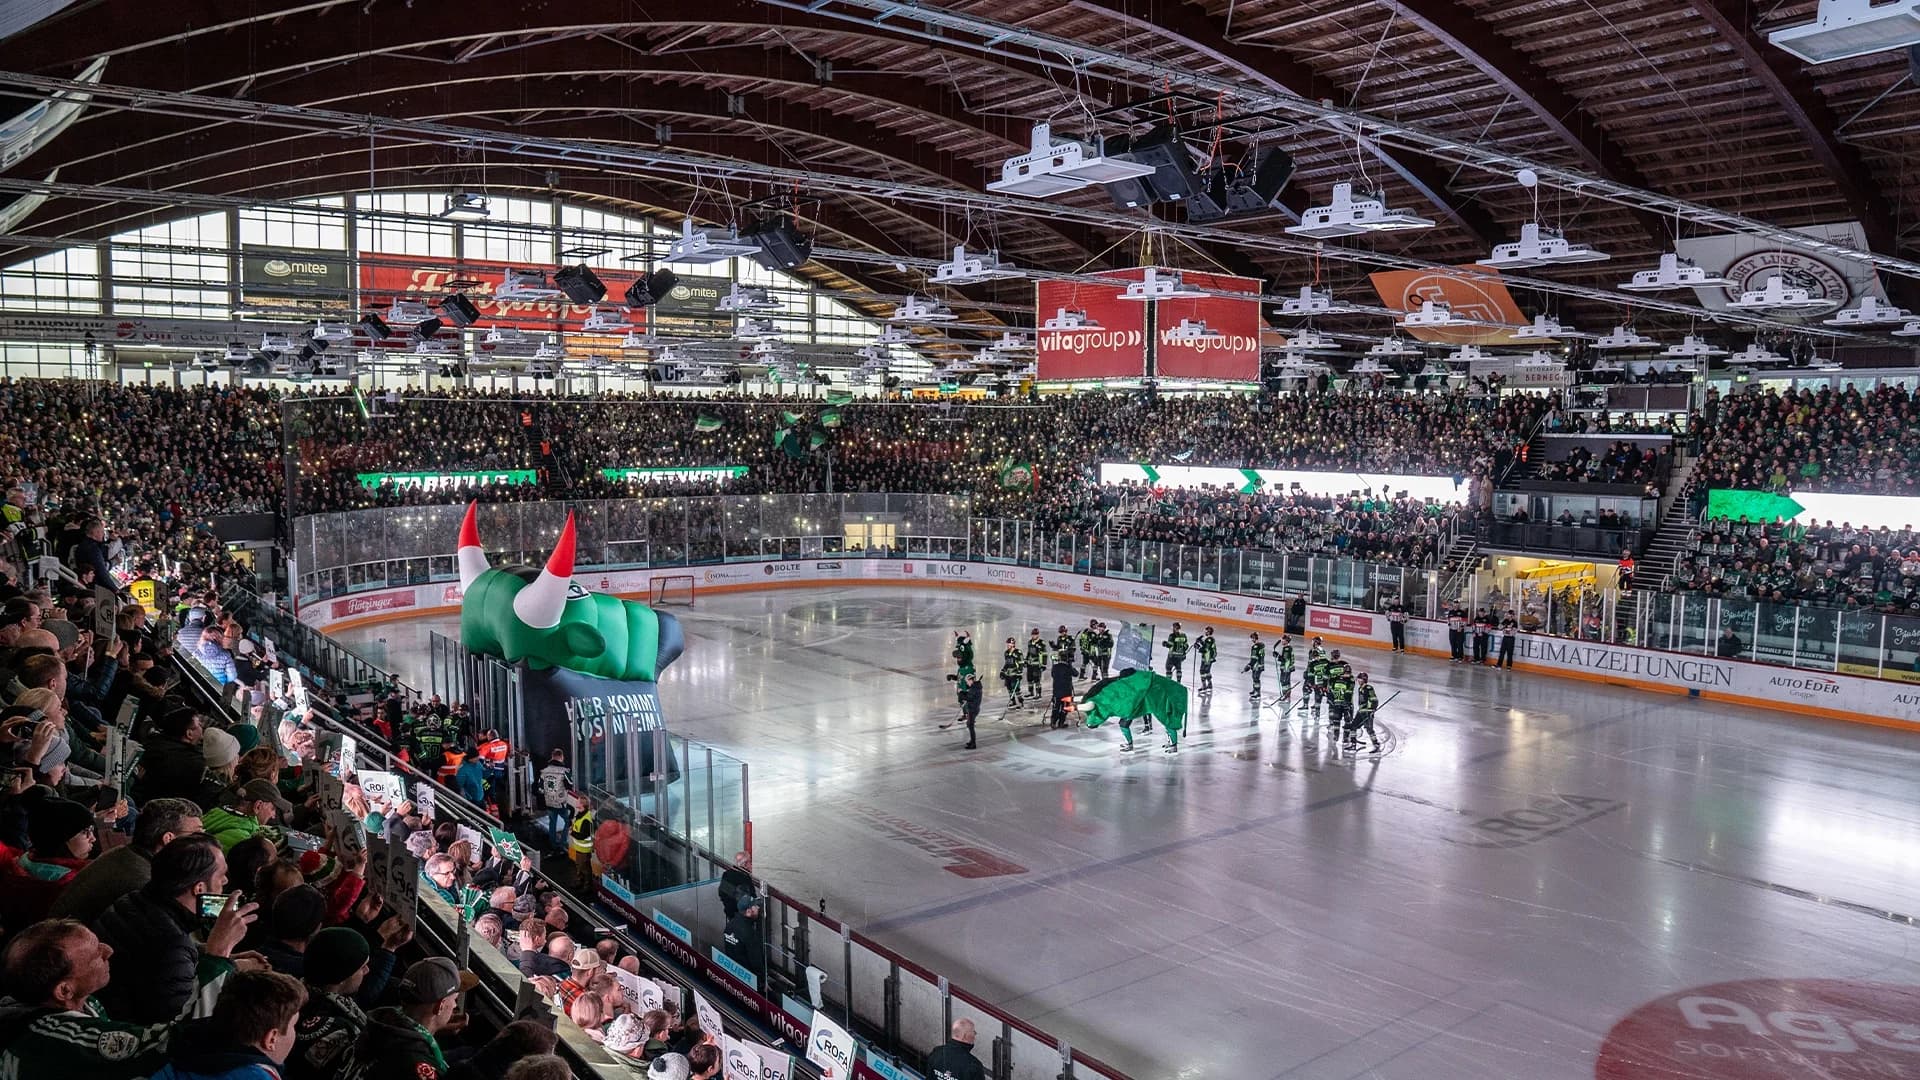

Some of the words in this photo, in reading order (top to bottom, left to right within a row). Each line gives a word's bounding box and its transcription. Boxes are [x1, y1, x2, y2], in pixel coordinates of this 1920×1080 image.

[291, 262, 328, 274] mitea
[1761, 254, 1800, 267] LINE
[691, 287, 718, 298] mitea
[1041, 331, 1125, 354] vitagroup
[774, 563, 800, 572] BOLTE
[939, 564, 967, 576] MCP
[987, 565, 1016, 580] komro
[1515, 638, 1734, 687] HEIMATZEITUNGEN
[1769, 677, 1803, 689] AUTO
[1804, 679, 1840, 694] EDER
[606, 693, 657, 713] KOMMT
[1470, 793, 1613, 838] ROFA
[657, 911, 688, 939] BAUER
[643, 922, 690, 966] vitagroup
[717, 953, 753, 983] BAUER
[706, 967, 760, 1013] #teamfuturehealth
[769, 1010, 808, 1048] vitagr
[823, 1040, 849, 1070] ROFA
